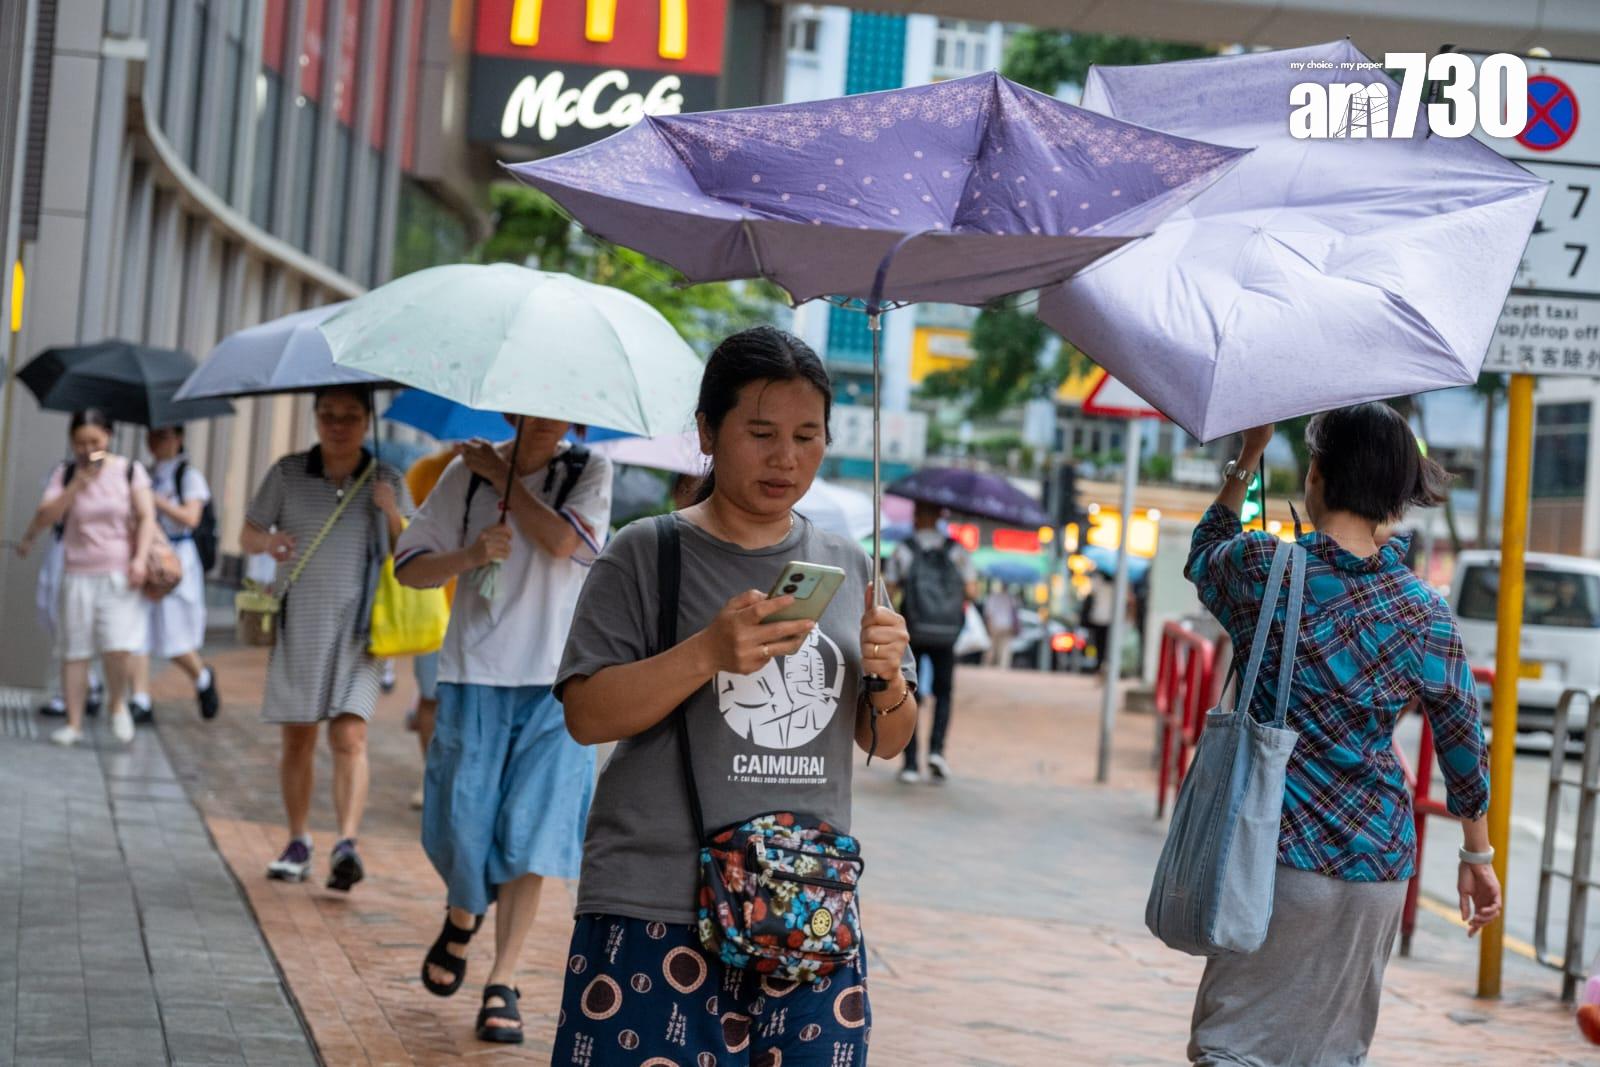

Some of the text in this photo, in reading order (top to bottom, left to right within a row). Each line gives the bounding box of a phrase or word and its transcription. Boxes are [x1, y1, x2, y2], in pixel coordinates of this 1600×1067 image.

[1567, 185, 1590, 219] 7
[1564, 243, 1588, 277] 7
[1546, 305, 1579, 319] taxi
[1574, 324, 1599, 340] off
[733, 754, 825, 775] CAIMURAI
